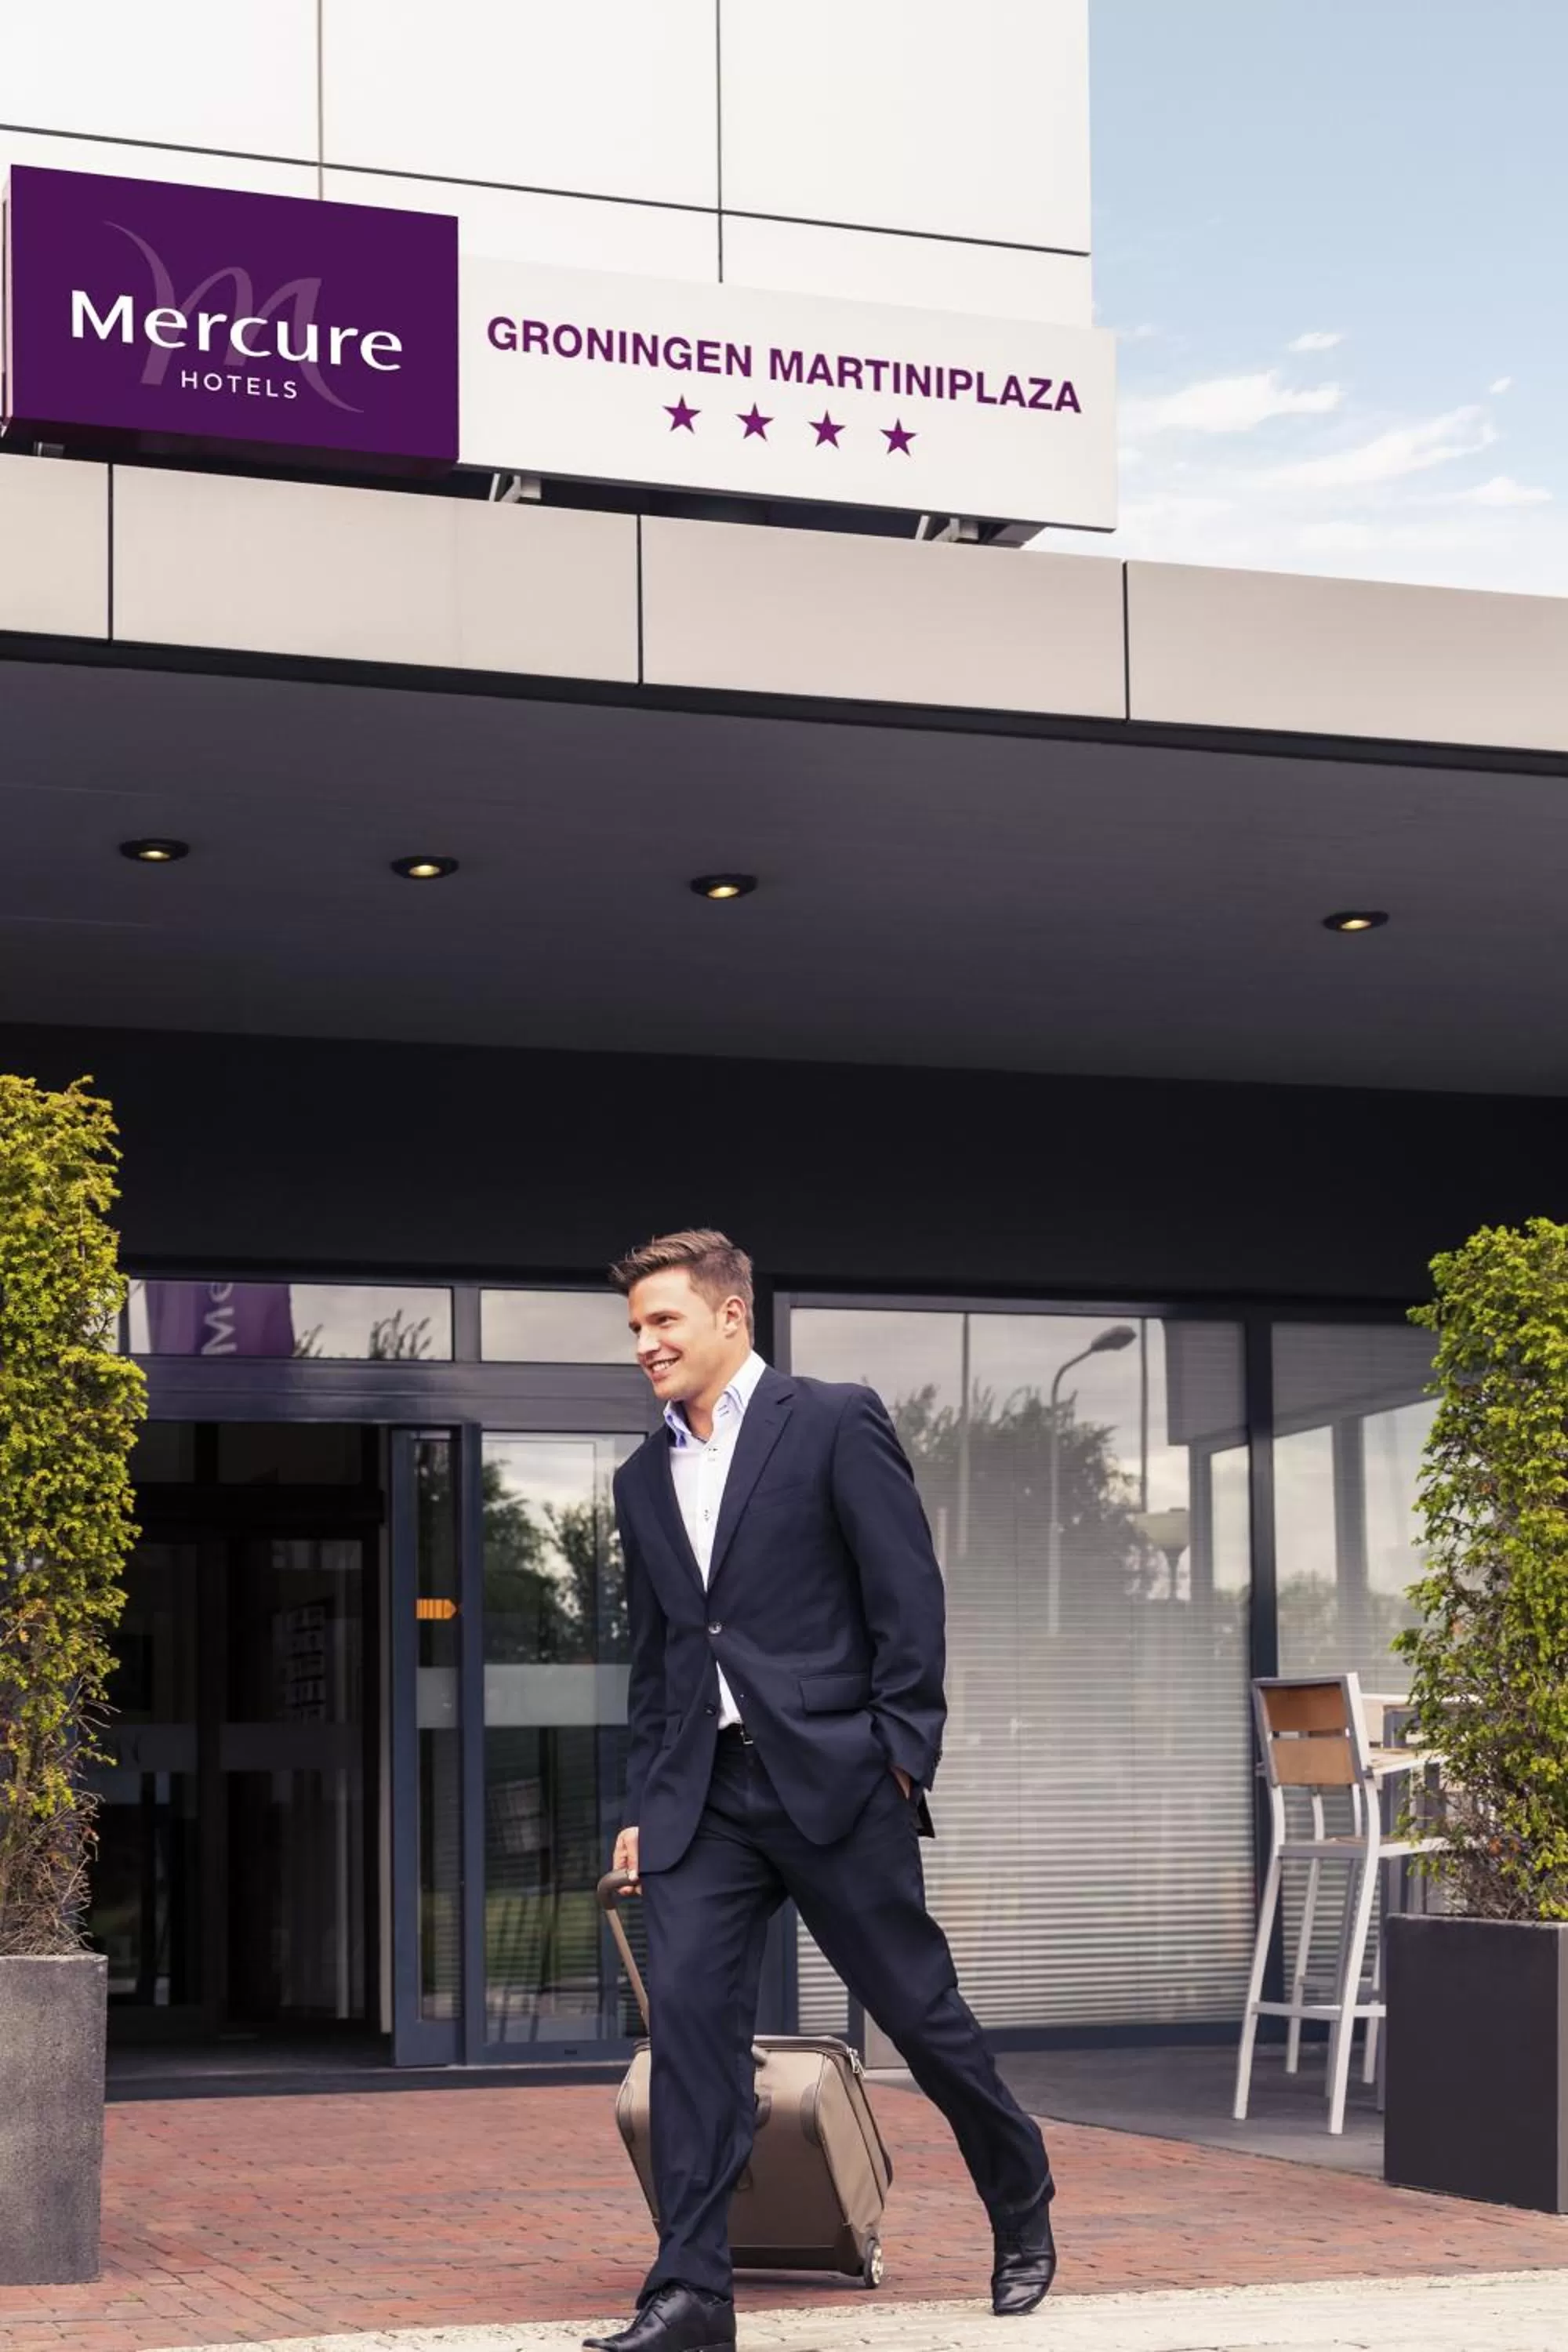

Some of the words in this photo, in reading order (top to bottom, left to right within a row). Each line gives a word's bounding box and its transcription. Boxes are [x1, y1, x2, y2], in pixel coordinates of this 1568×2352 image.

[71, 289, 403, 371] Mercure
[486, 315, 753, 379] GRONINGEN
[769, 347, 1083, 415] MARTINIPLAZA
[180, 369, 298, 400] HOTELS
